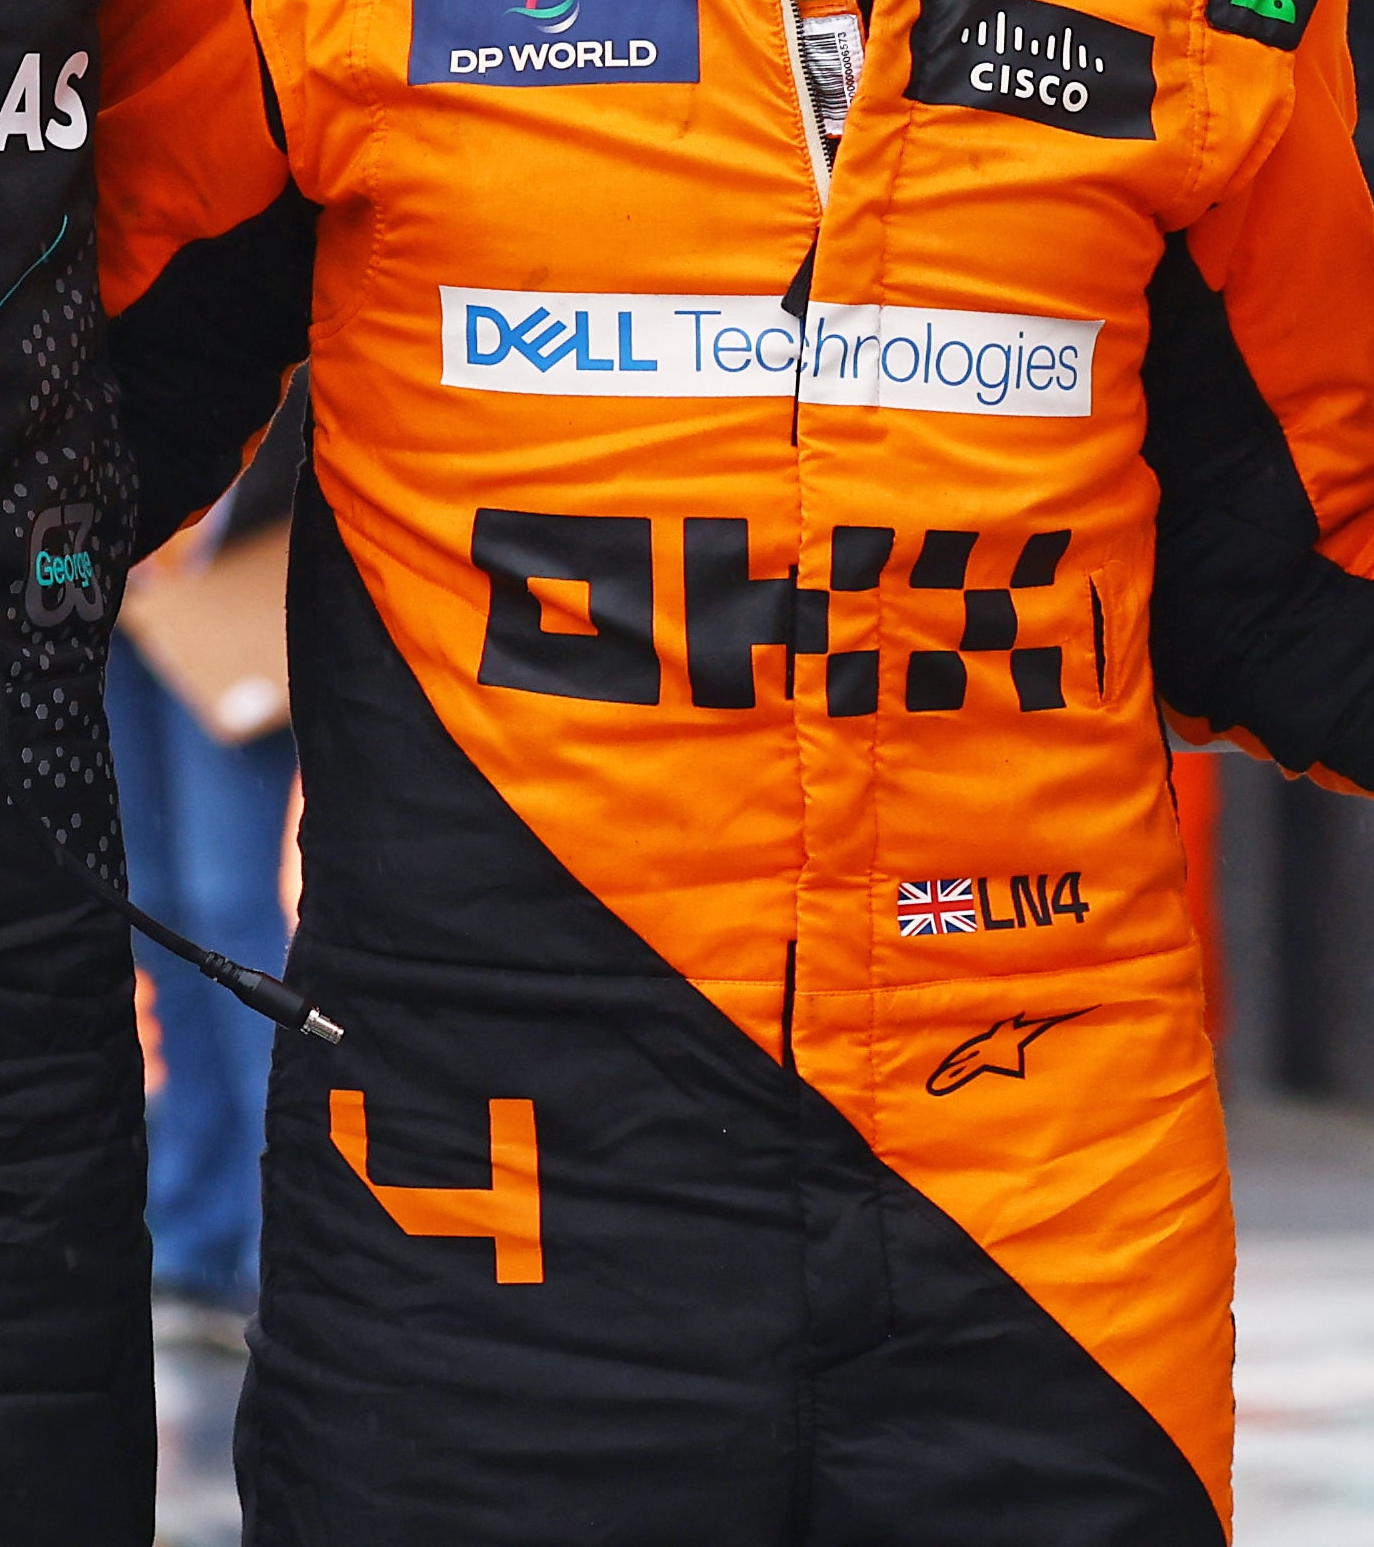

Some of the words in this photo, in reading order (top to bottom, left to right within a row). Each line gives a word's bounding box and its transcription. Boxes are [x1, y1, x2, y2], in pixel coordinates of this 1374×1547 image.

[449, 46, 505, 75] DP
[509, 39, 659, 73] WORLD
[465, 304, 660, 373] DELL
[673, 308, 1081, 407] Technologies
[35, 550, 94, 589] George
[977, 871, 1091, 931] LN4
[328, 1088, 545, 1284] 4
